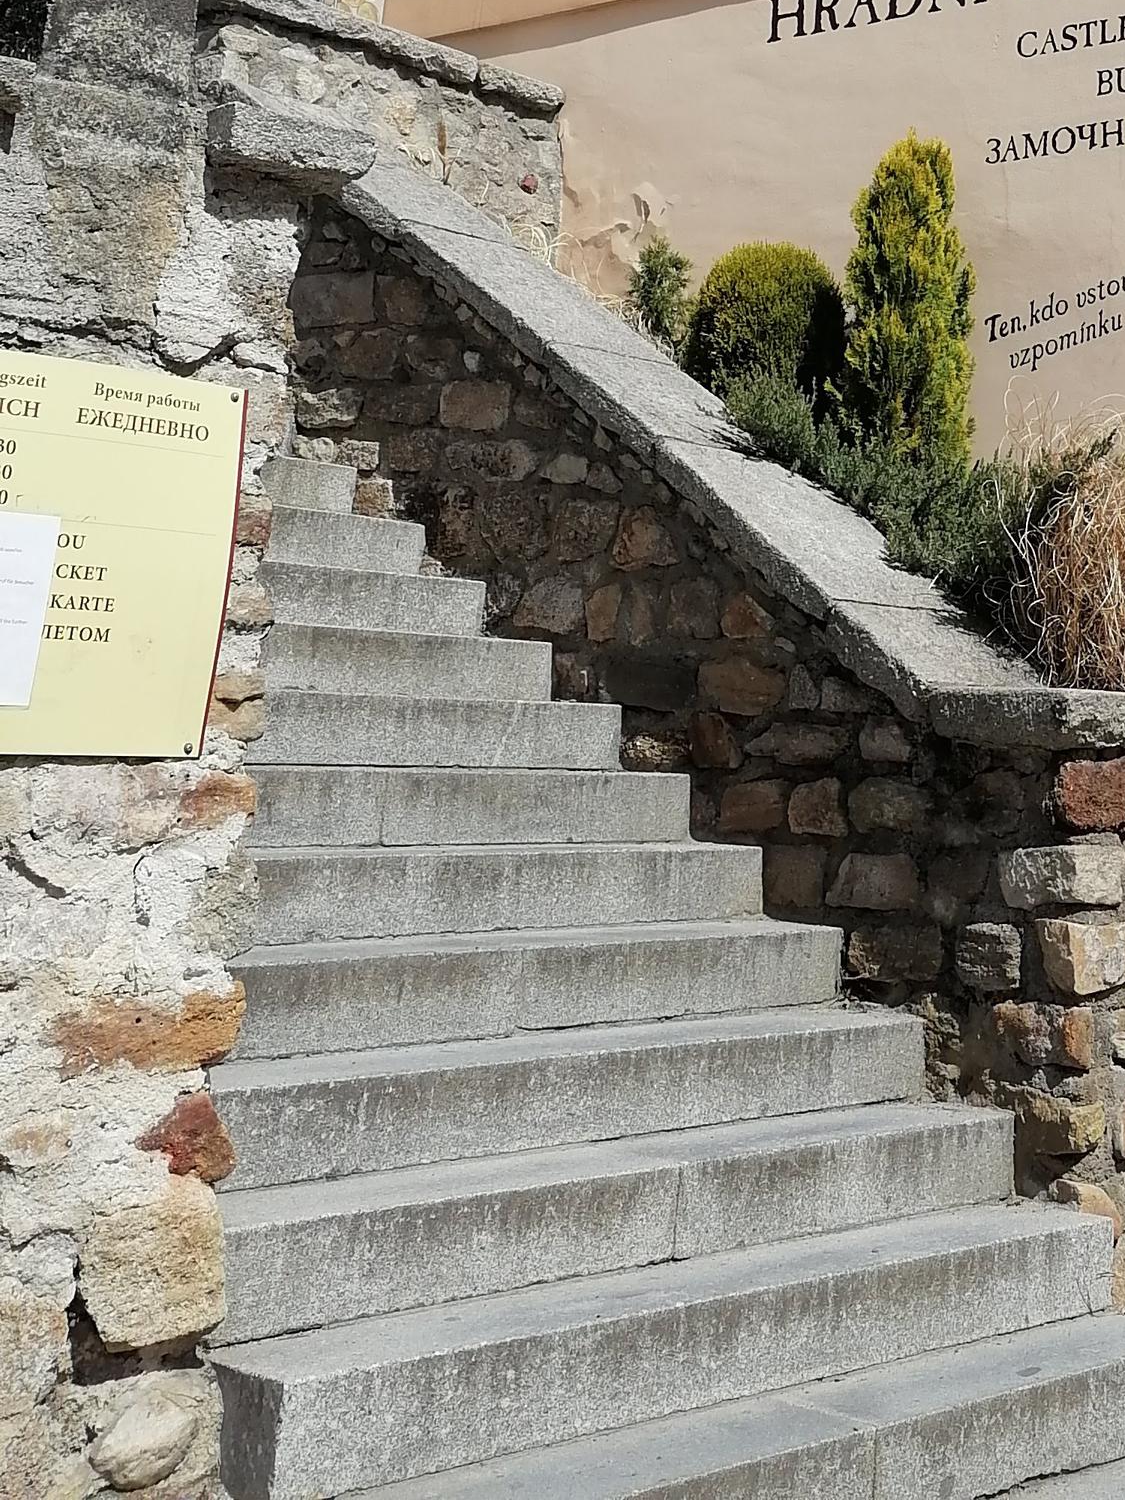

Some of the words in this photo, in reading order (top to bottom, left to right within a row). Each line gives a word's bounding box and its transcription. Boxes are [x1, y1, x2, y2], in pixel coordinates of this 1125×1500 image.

[1009, 309, 1122, 372] vzpomínku
[93, 381, 143, 404] Время
[146, 393, 201, 413] работы
[75, 406, 209, 442] ЕЖЕДНЕВНО
[53, 563, 108, 583] CKET
